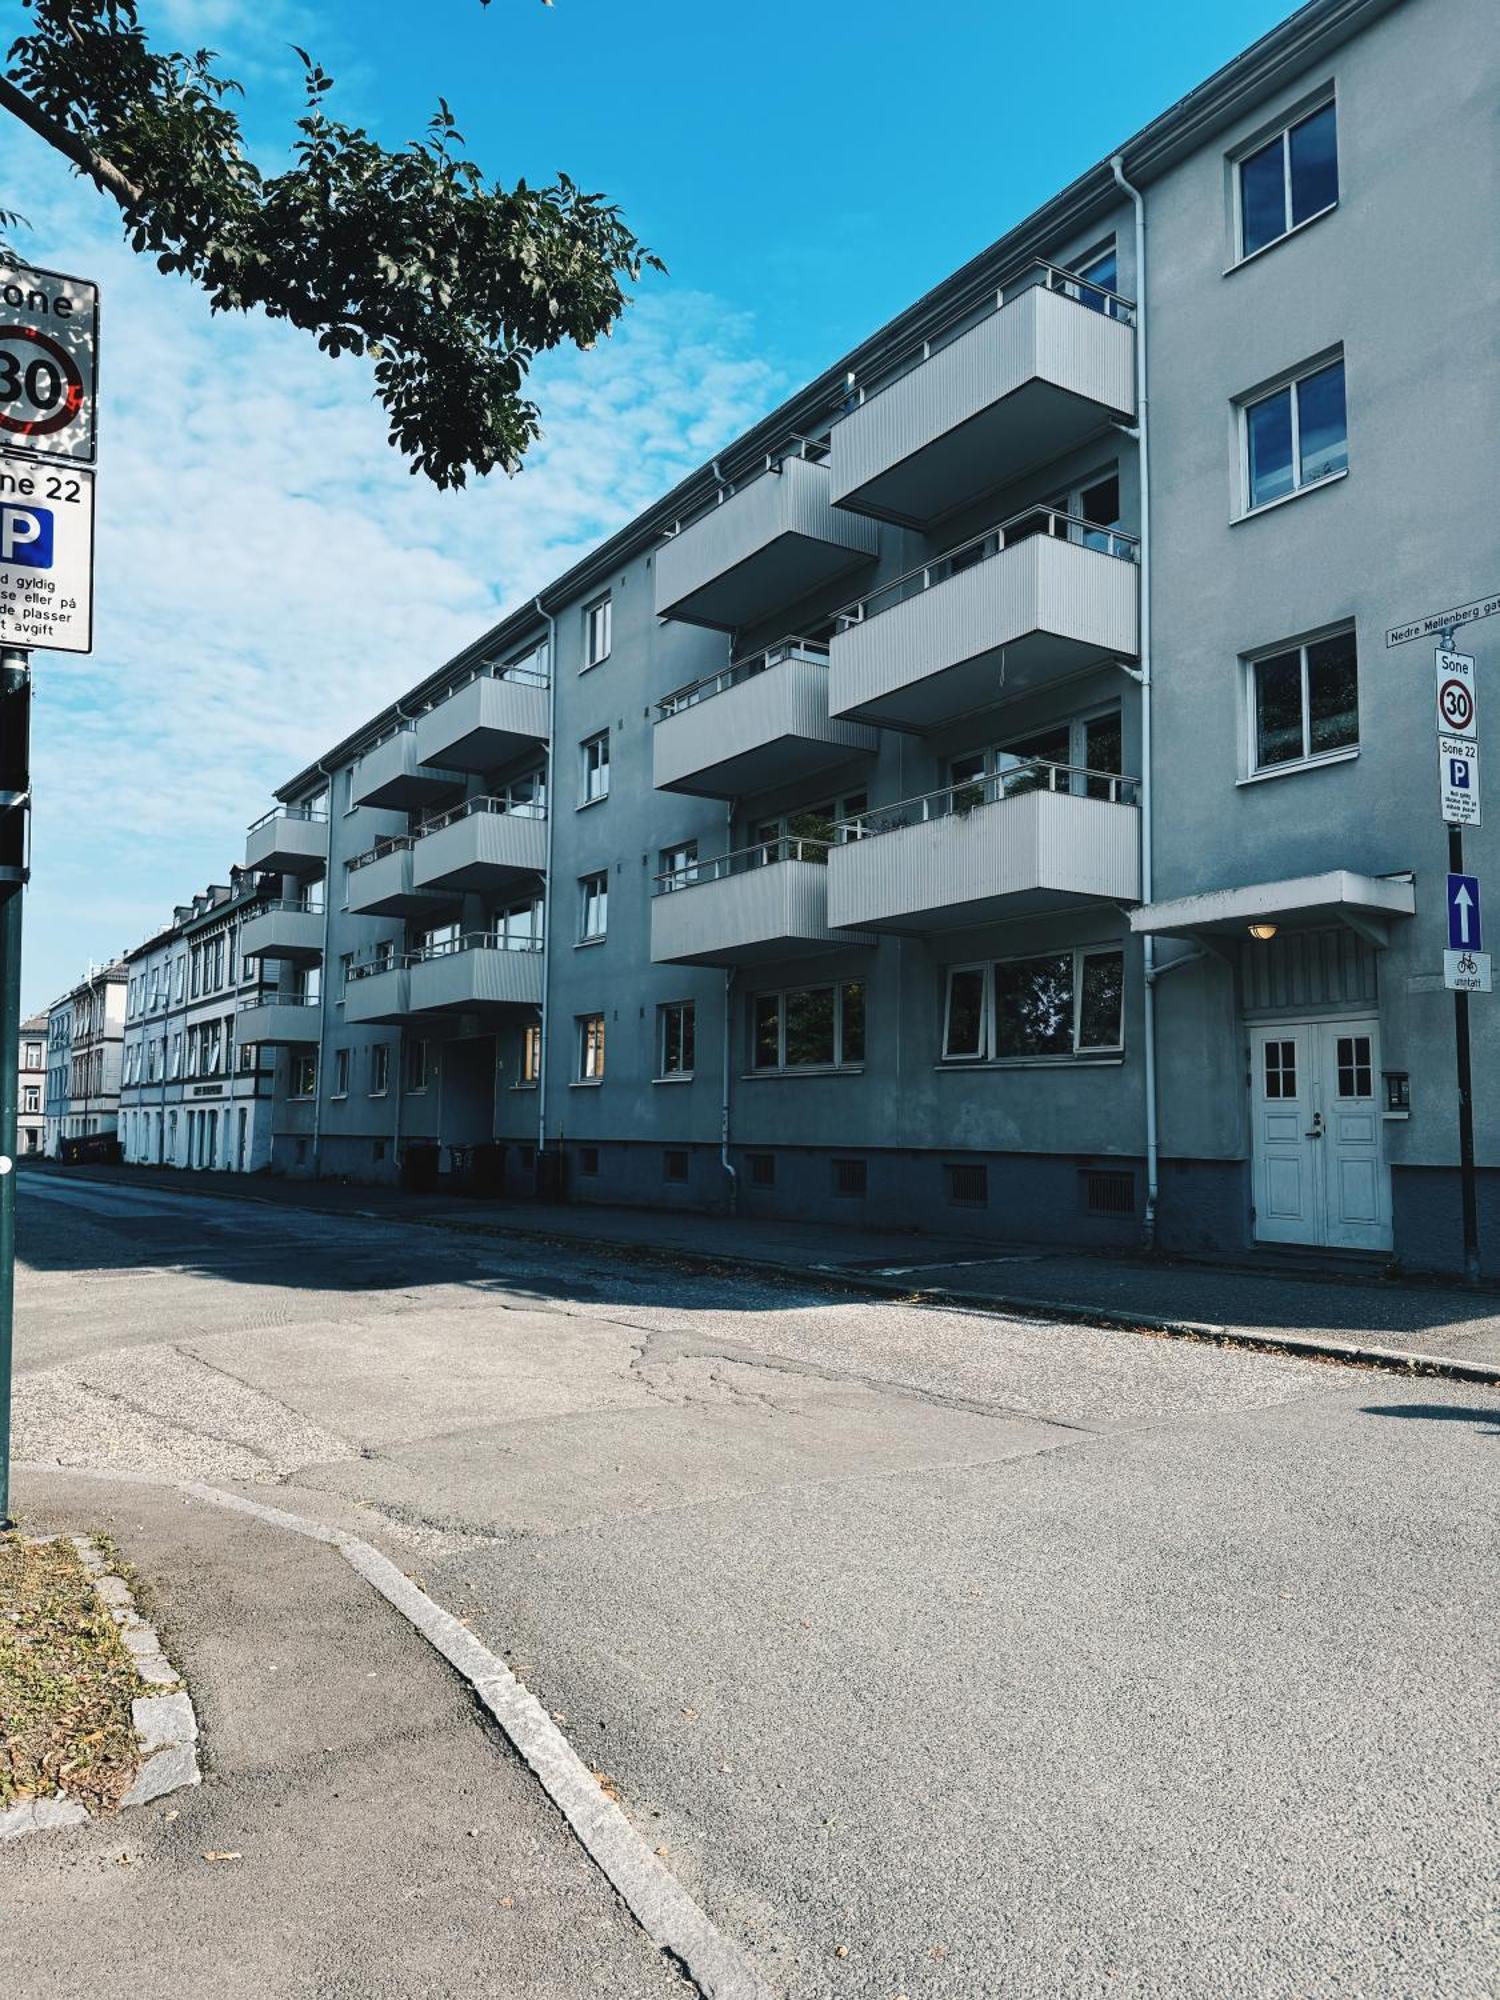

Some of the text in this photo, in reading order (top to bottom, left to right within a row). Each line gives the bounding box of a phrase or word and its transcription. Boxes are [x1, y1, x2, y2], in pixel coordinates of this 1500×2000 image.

[0, 350, 62, 410] 30
[46, 476, 81, 504] 22
[3, 508, 41, 559] P
[16, 577, 56, 594] gyldig
[24, 592, 53, 606] eller
[60, 597, 77, 610] på
[23, 607, 73, 623] plasser
[14, 622, 54, 637] avgift
[1391, 625, 1420, 643] Nedre
[1442, 655, 1469, 675] Sone
[1446, 691, 1468, 718] 30
[1442, 741, 1476, 758] Sone 22
[1454, 761, 1466, 785] P
